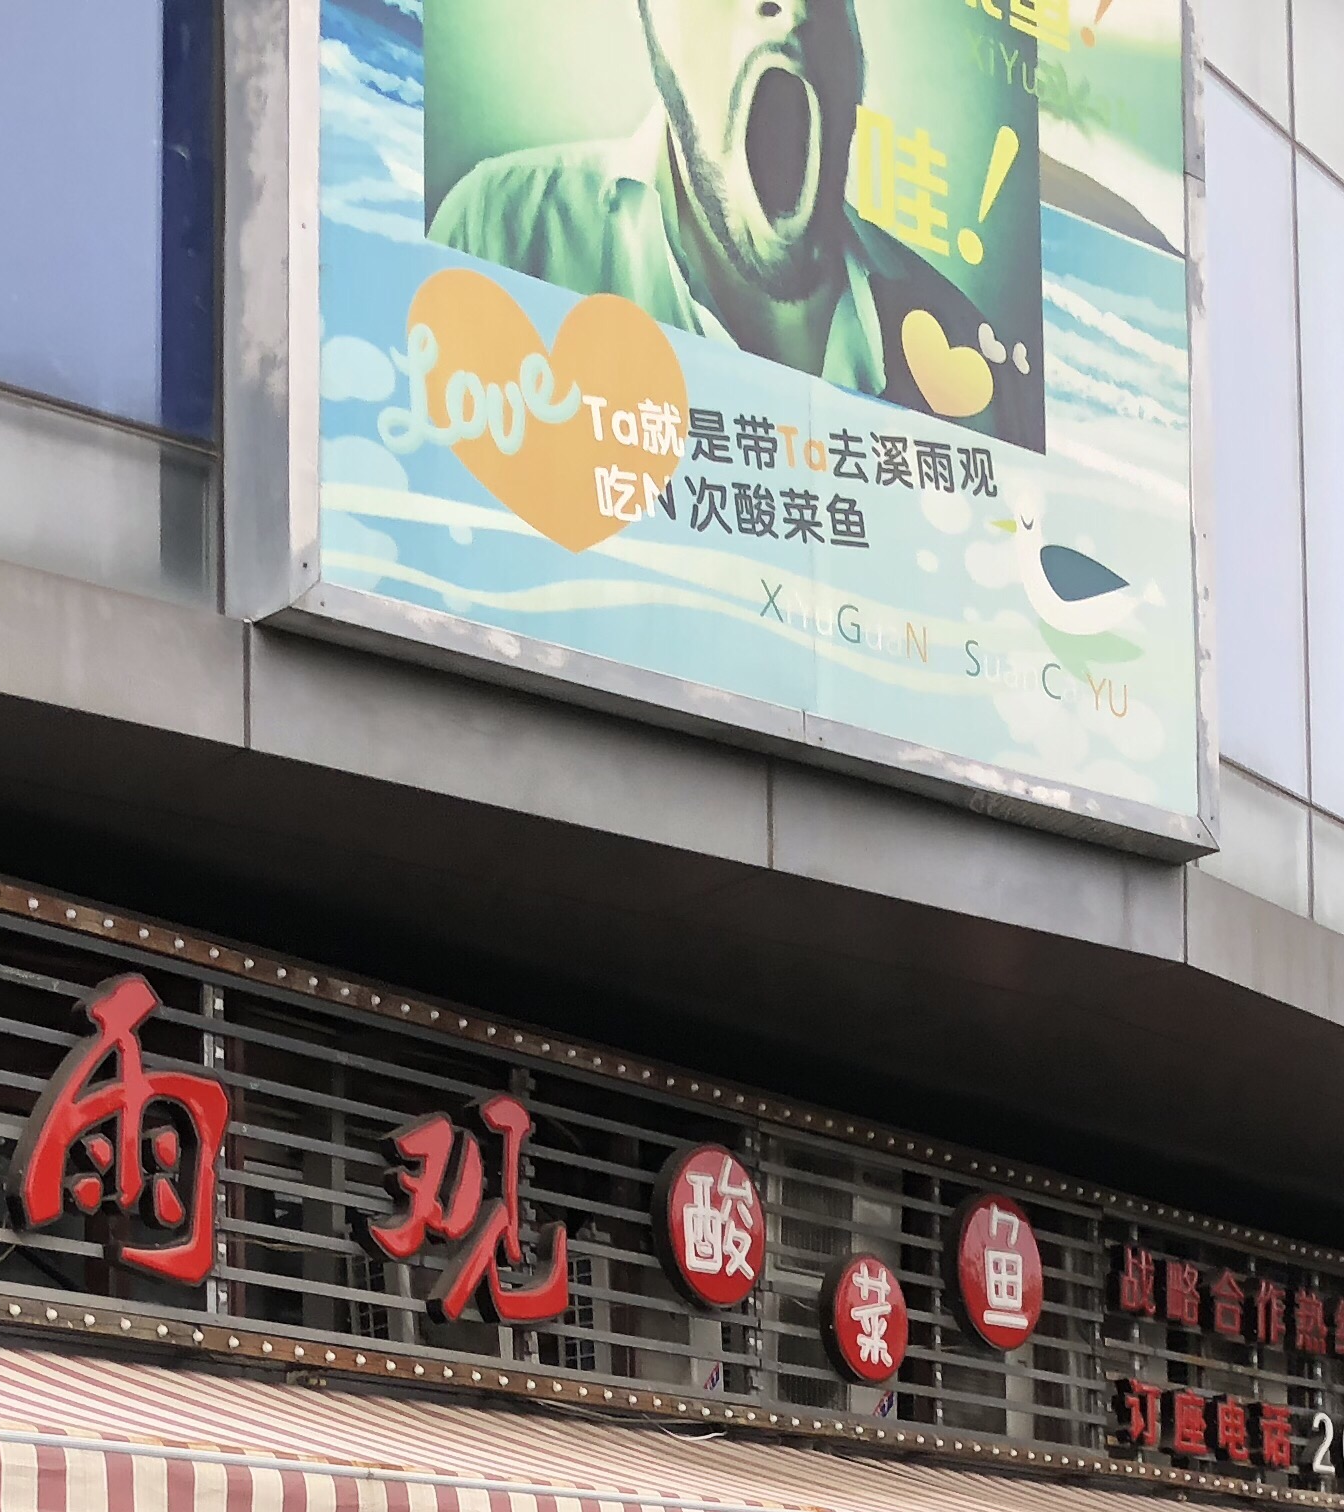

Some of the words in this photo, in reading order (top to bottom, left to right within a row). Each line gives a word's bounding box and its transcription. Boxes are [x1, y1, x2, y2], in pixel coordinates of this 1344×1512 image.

[858, 104, 1021, 266] 哇!
[376, 324, 582, 455] Love
[581, 395, 999, 500] Ta就是带Ta去溪雨观
[594, 464, 870, 549] 吃N次酸菜鱼
[682, 1157, 1032, 1368] 酸菜鱼
[1124, 1378, 1293, 1469] 订座电话
